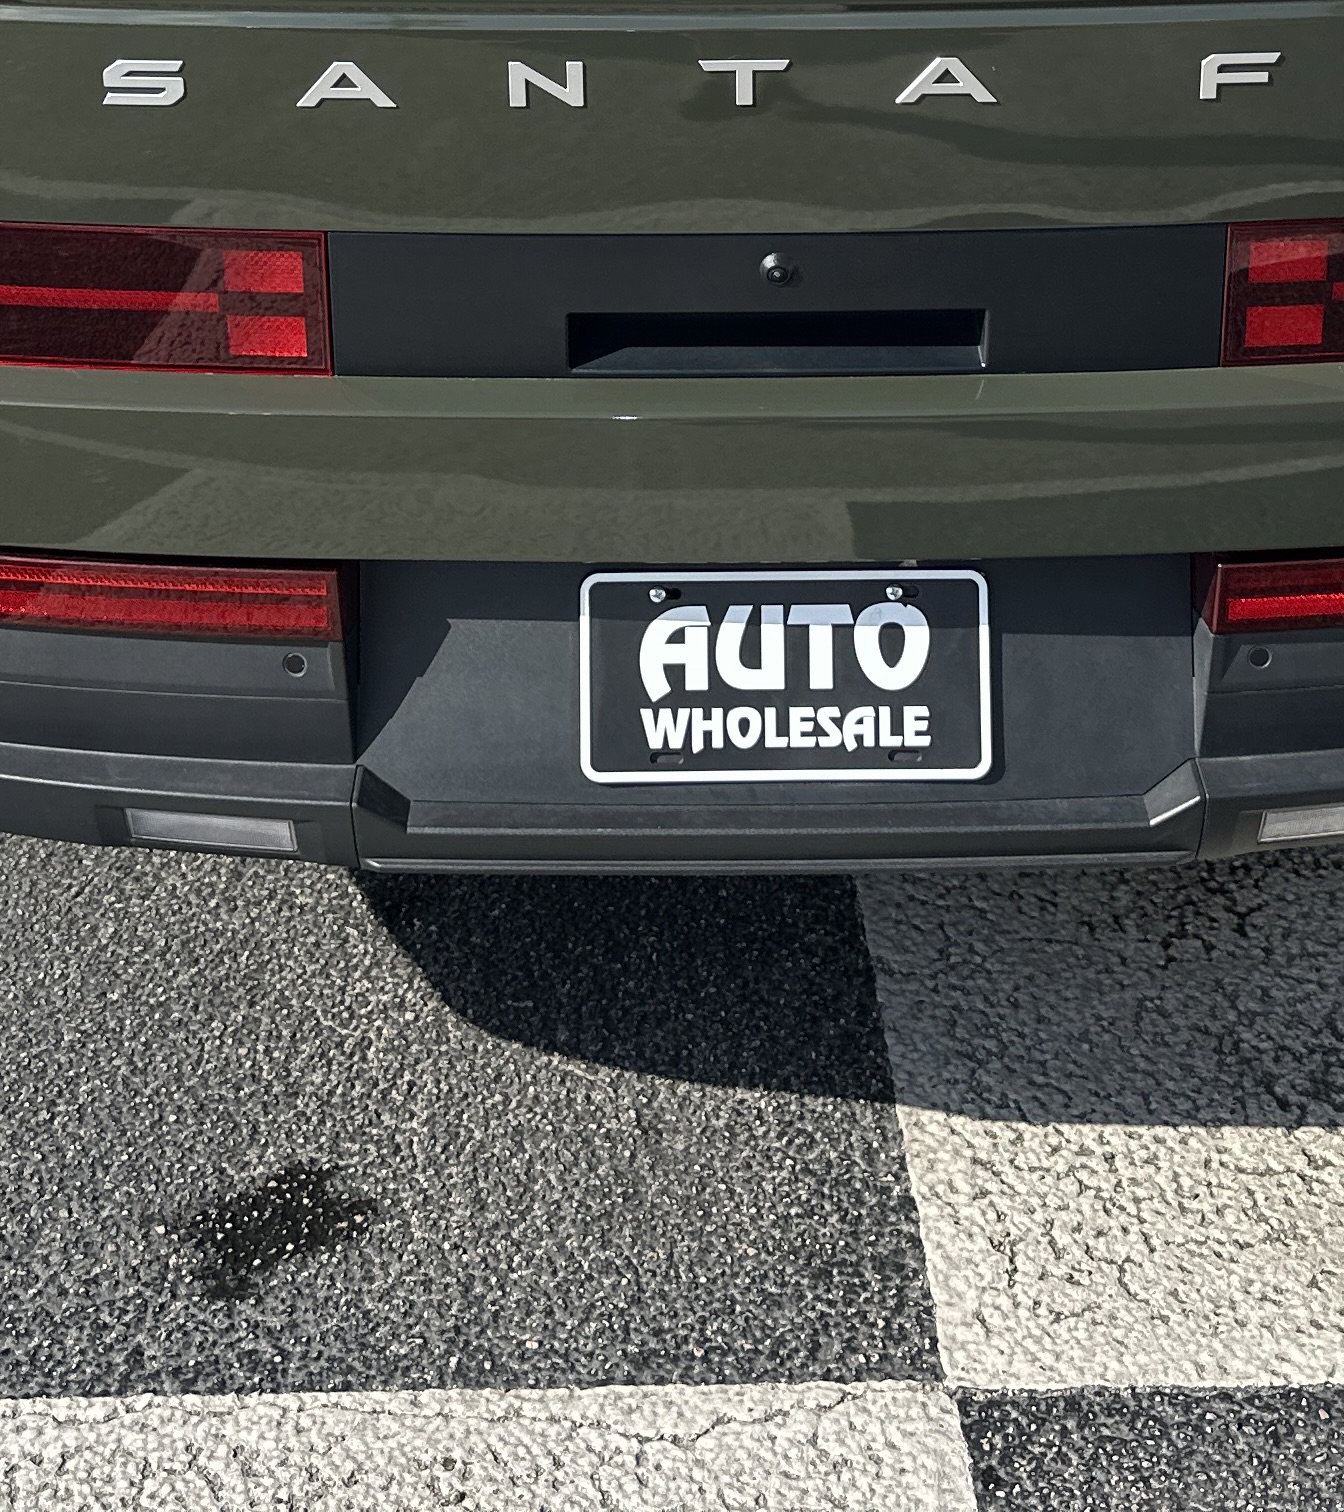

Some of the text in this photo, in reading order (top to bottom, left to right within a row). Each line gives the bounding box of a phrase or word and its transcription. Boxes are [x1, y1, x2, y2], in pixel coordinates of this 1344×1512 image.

[102, 57, 998, 108] SANTA
[639, 601, 931, 703] AUTO
[639, 705, 932, 754] WHOLESALE
